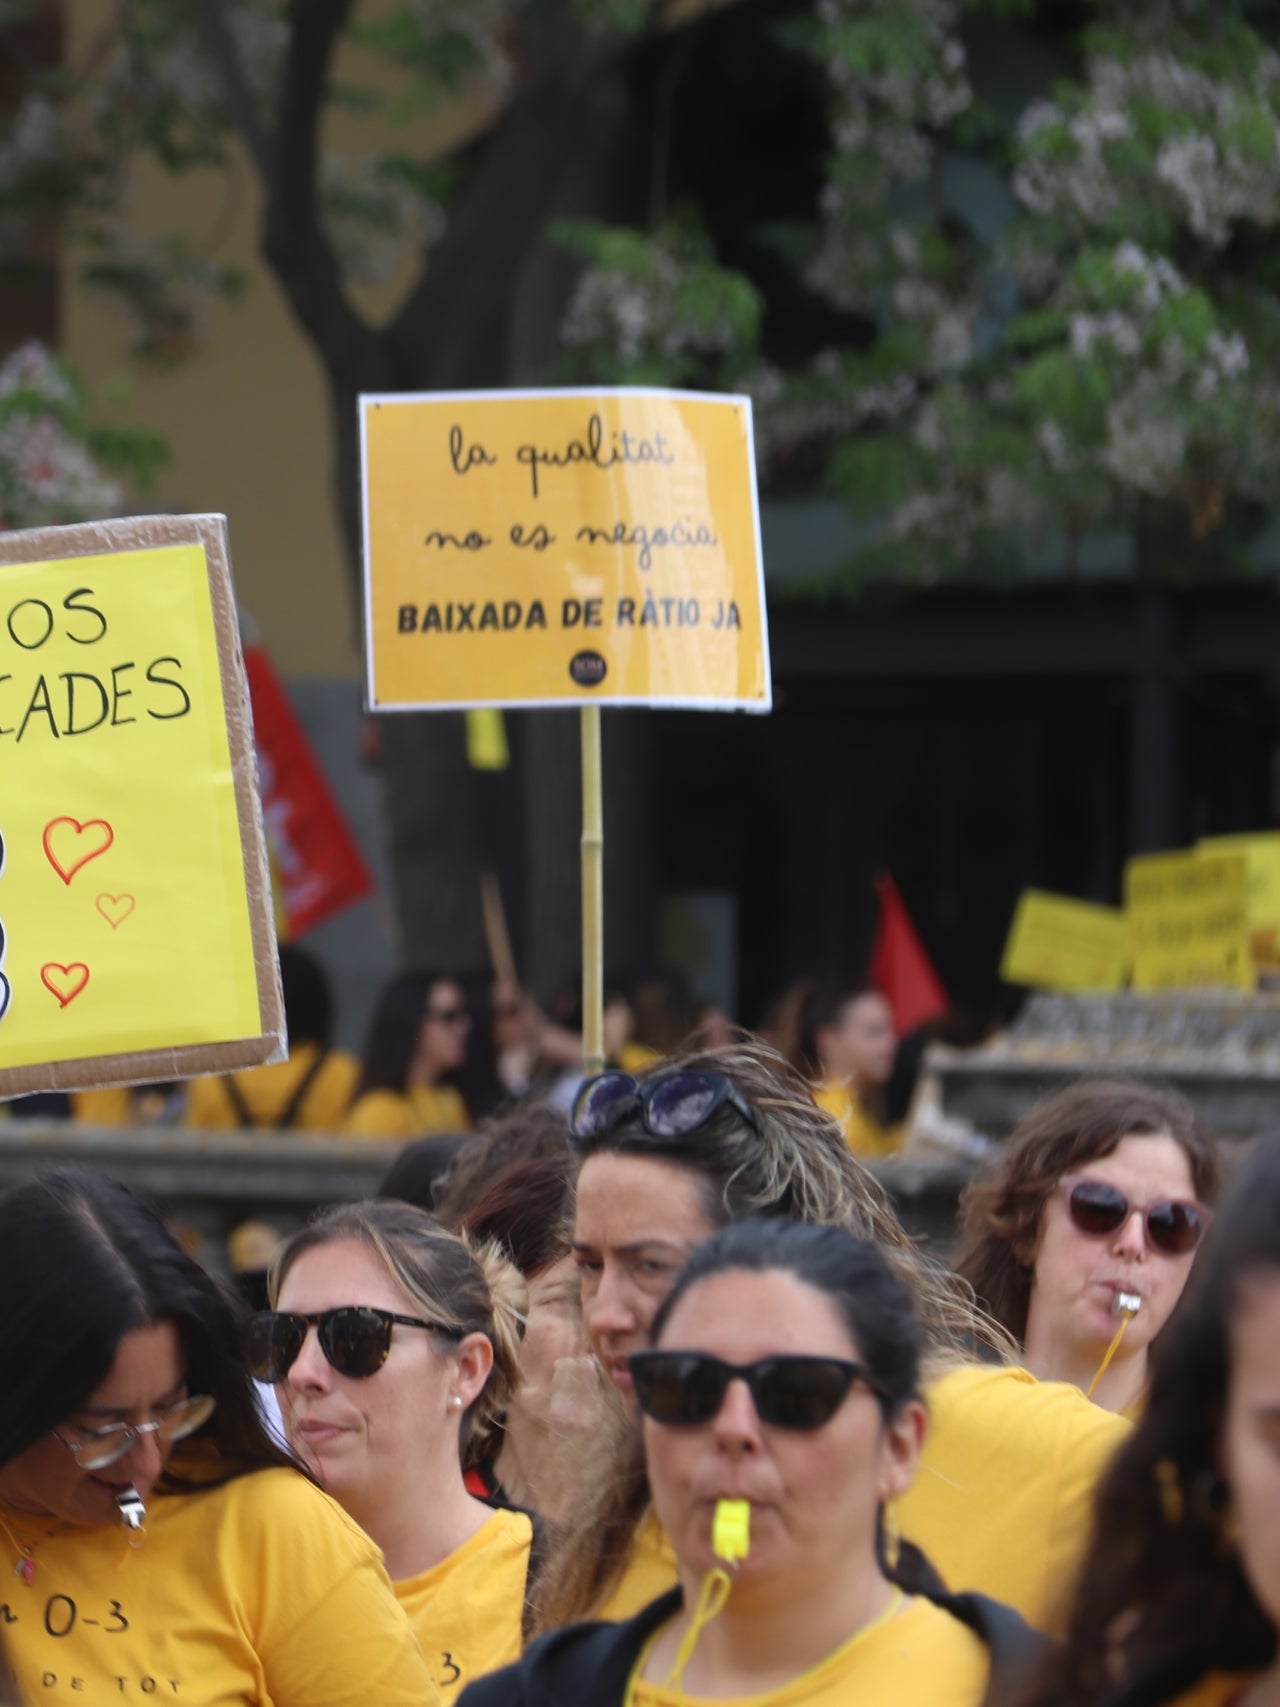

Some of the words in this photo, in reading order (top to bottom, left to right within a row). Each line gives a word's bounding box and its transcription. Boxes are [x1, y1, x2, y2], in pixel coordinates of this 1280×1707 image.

[449, 423, 497, 475] la
[516, 412, 674, 499] qualitat
[424, 529, 492, 551] no
[509, 524, 556, 551] es
[397, 601, 548, 635] BAIXADA
[561, 597, 604, 629] DE
[616, 587, 701, 630] RÀTIO
[709, 601, 743, 632] JA
[41, 1670, 84, 1692] DE
[115, 1674, 181, 1695] TOT
